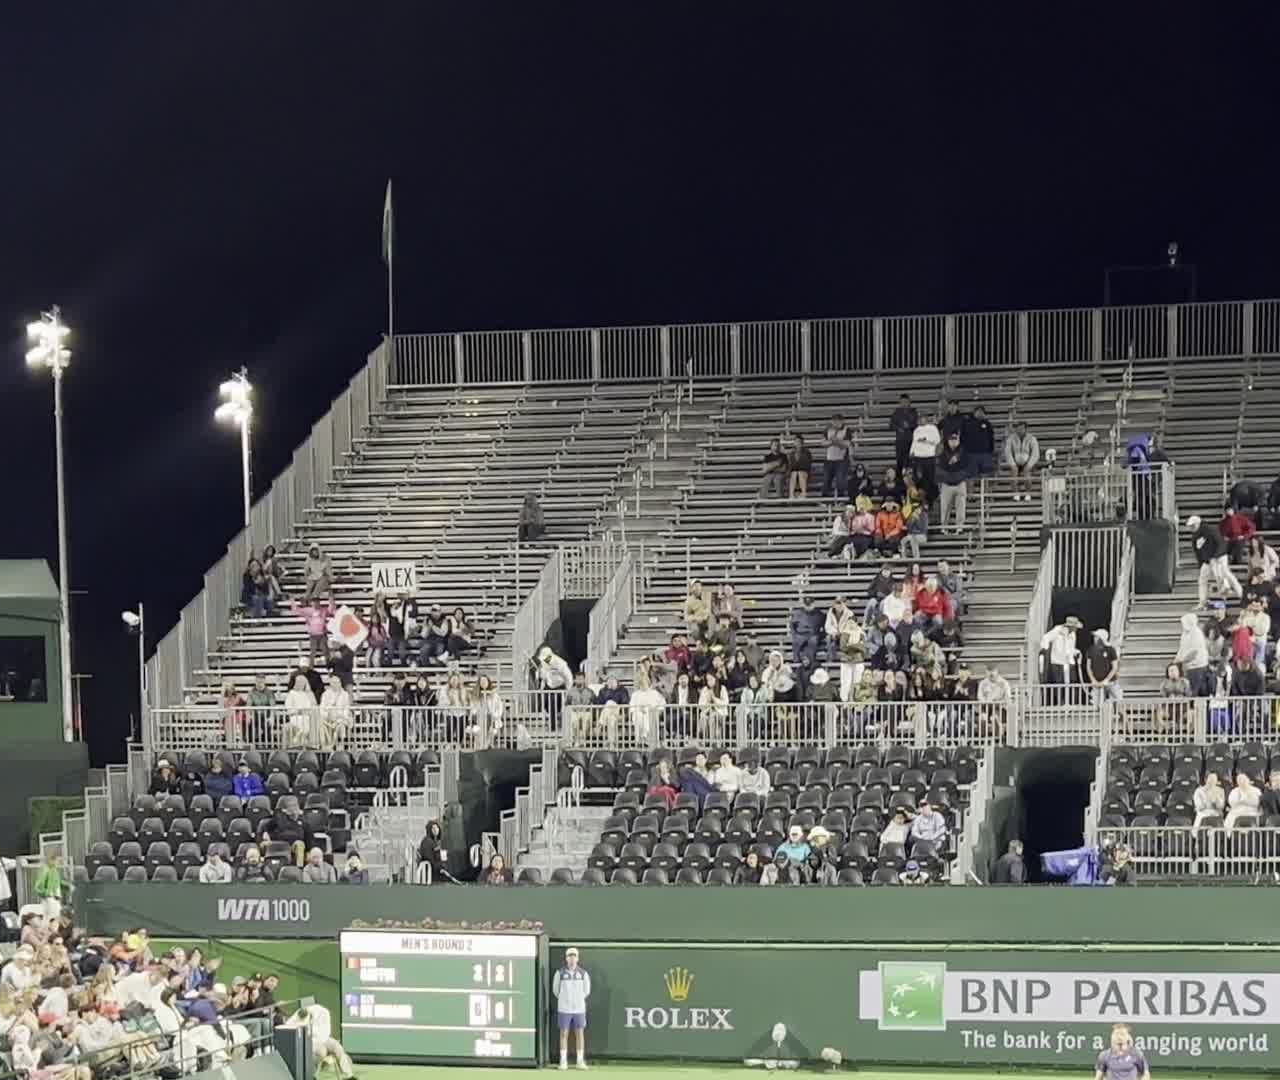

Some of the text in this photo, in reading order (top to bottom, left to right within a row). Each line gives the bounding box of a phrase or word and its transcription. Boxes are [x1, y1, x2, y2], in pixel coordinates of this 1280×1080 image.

[376, 567, 413, 588] ALEX
[960, 978, 1268, 1017] BNP PARIBAS
[624, 1006, 735, 1030] ROLEX
[960, 1030, 1270, 1056] The bank for a anging world
